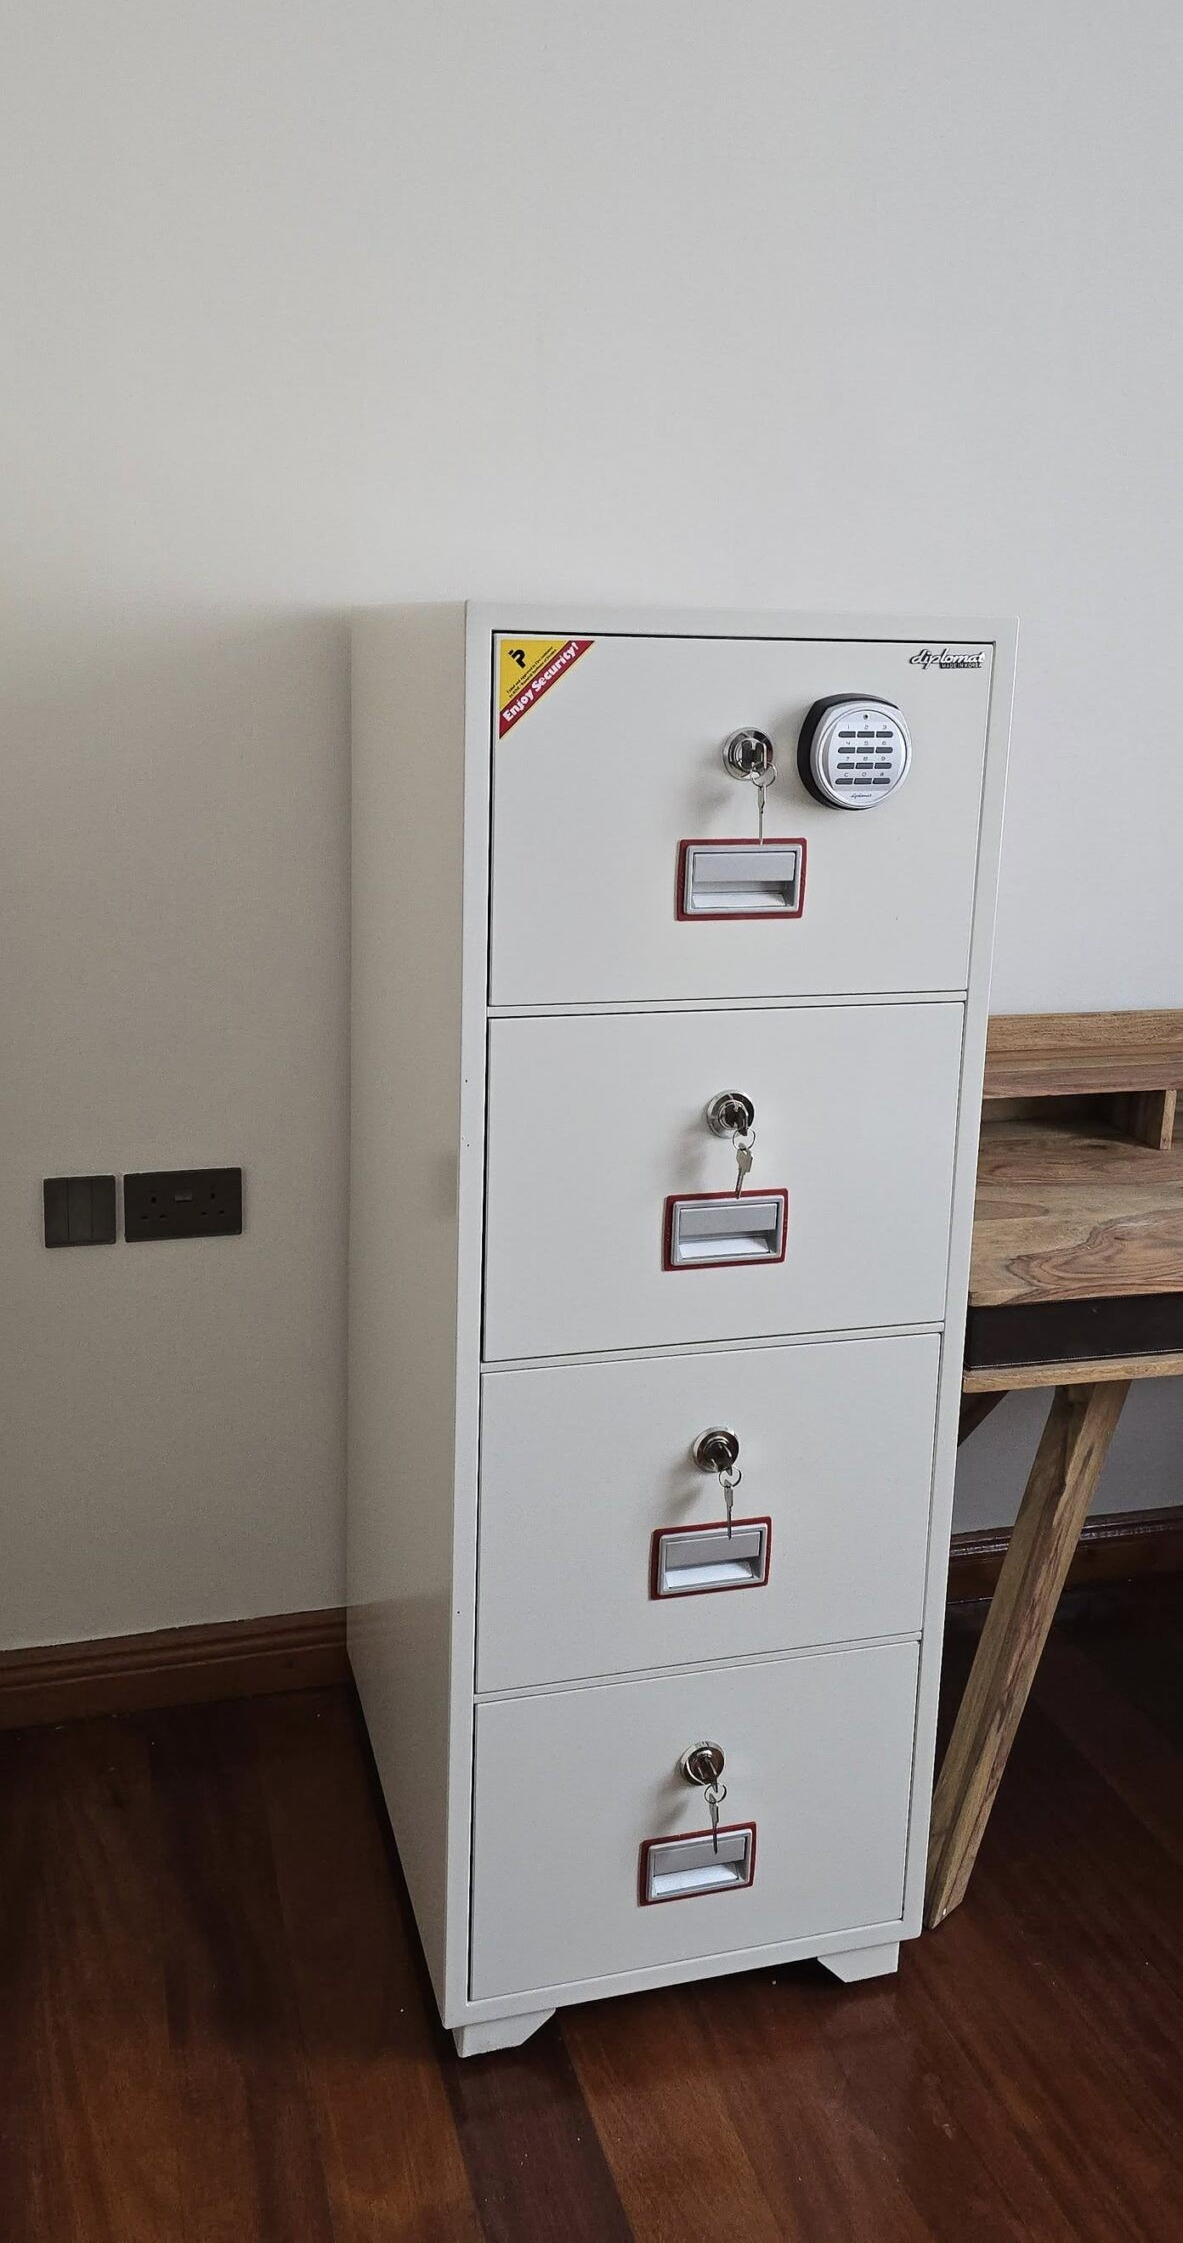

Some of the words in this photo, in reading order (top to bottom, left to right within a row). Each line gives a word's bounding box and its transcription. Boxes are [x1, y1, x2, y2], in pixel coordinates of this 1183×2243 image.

[502, 689, 534, 722] Enjoy
[531, 641, 579, 692] Security!
[909, 648, 986, 670] diplomat
